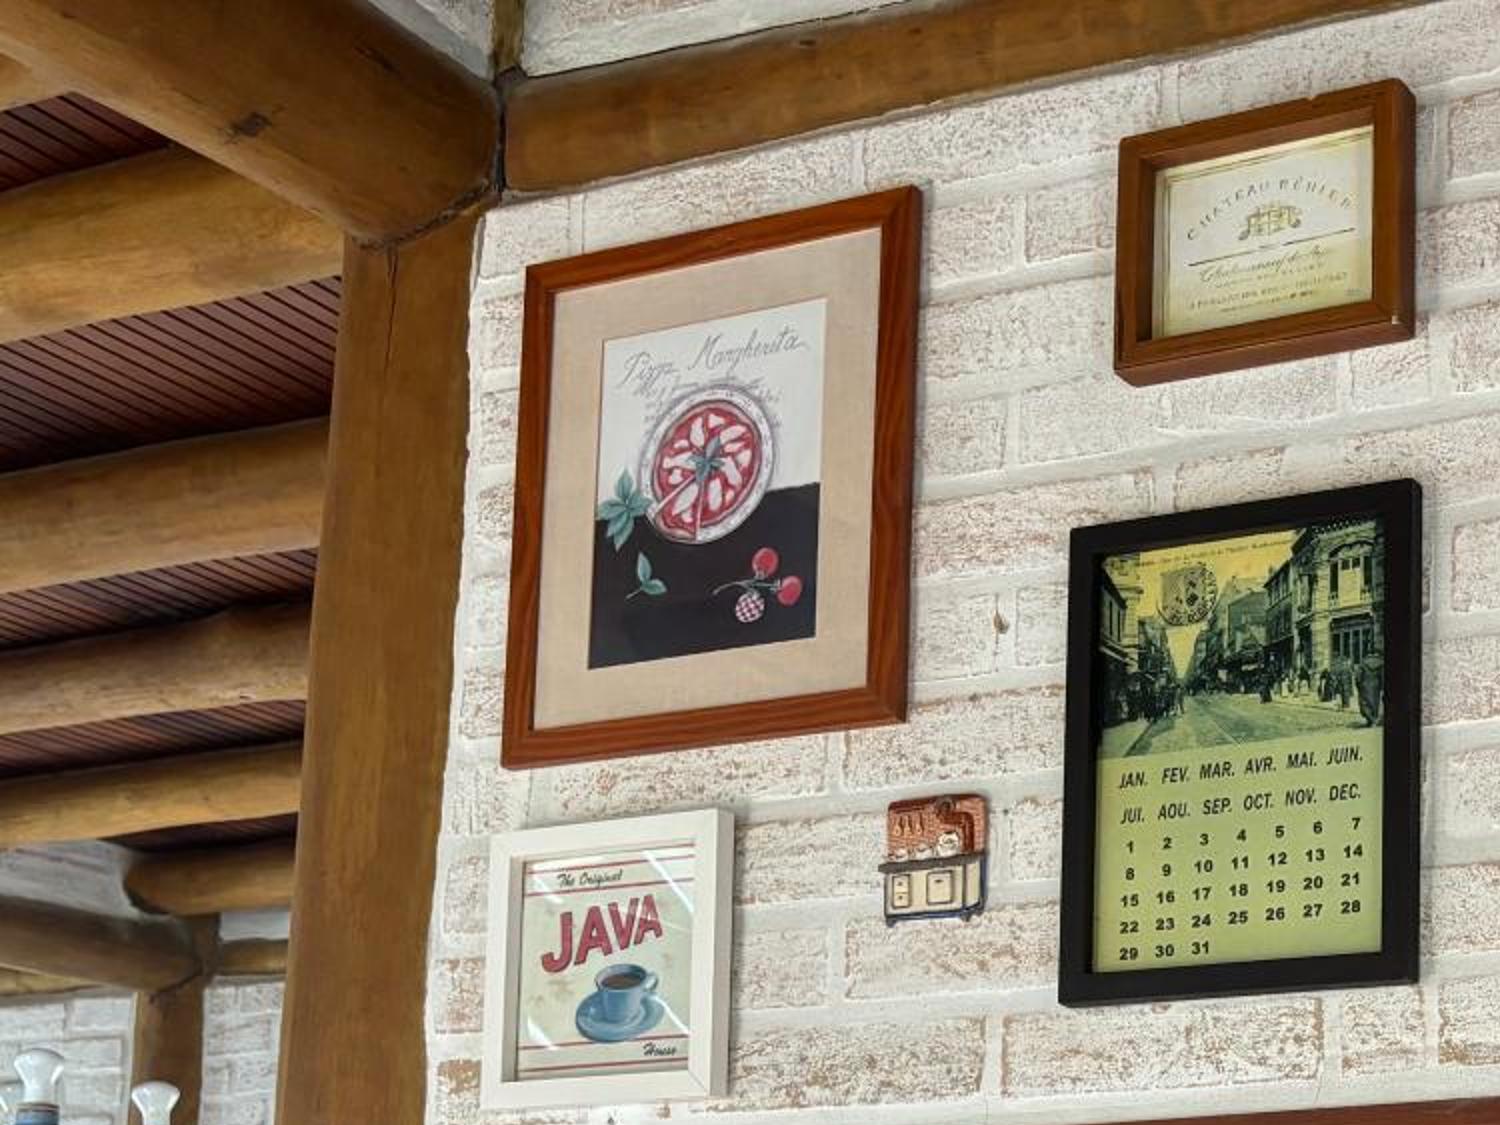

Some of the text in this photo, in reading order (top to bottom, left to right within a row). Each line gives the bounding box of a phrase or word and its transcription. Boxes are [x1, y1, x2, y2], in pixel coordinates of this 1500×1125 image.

[1118, 745, 1363, 790] JAN. FEV. MAR. AVR. MAI. JUIN.
[1119, 783, 1361, 825] JUI. AOU. SEP. OCT. NOV. DEC.
[1126, 816, 1361, 854] 1 2 3 4 5 6 7
[556, 868, 623, 889] The Original
[1125, 843, 1363, 881] 8 9 10 11 12 13 14
[1120, 871, 1360, 908] 15 16 17 18 19 20 21
[541, 893, 664, 973] JAVA
[1119, 899, 1361, 935] 22 23 24 25 26 27 28
[1119, 940, 1210, 961] 29 30 31
